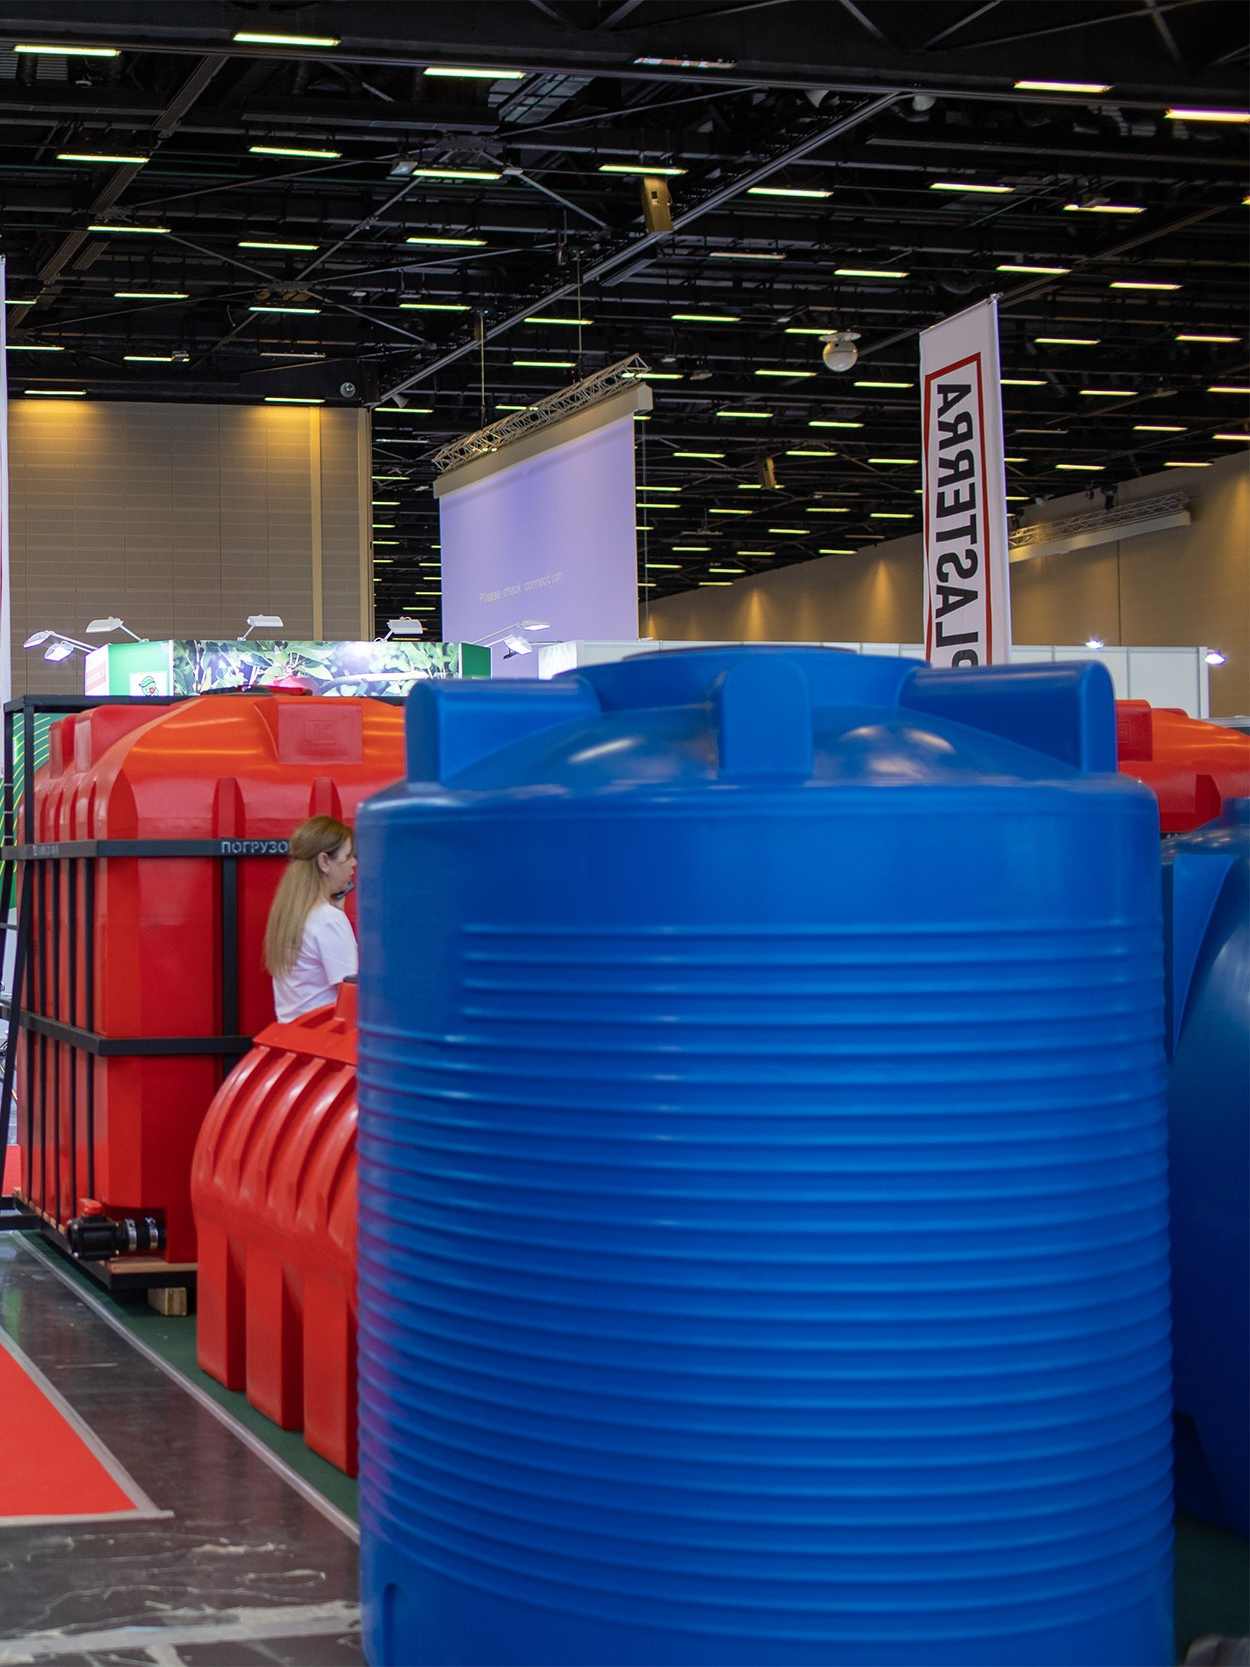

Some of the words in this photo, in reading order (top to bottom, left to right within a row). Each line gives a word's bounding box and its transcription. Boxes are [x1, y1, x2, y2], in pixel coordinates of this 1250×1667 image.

[479, 590, 501, 603] Please
[503, 583, 522, 598] check
[524, 571, 563, 592] connection
[221, 840, 292, 854] ПОГРУЗО
